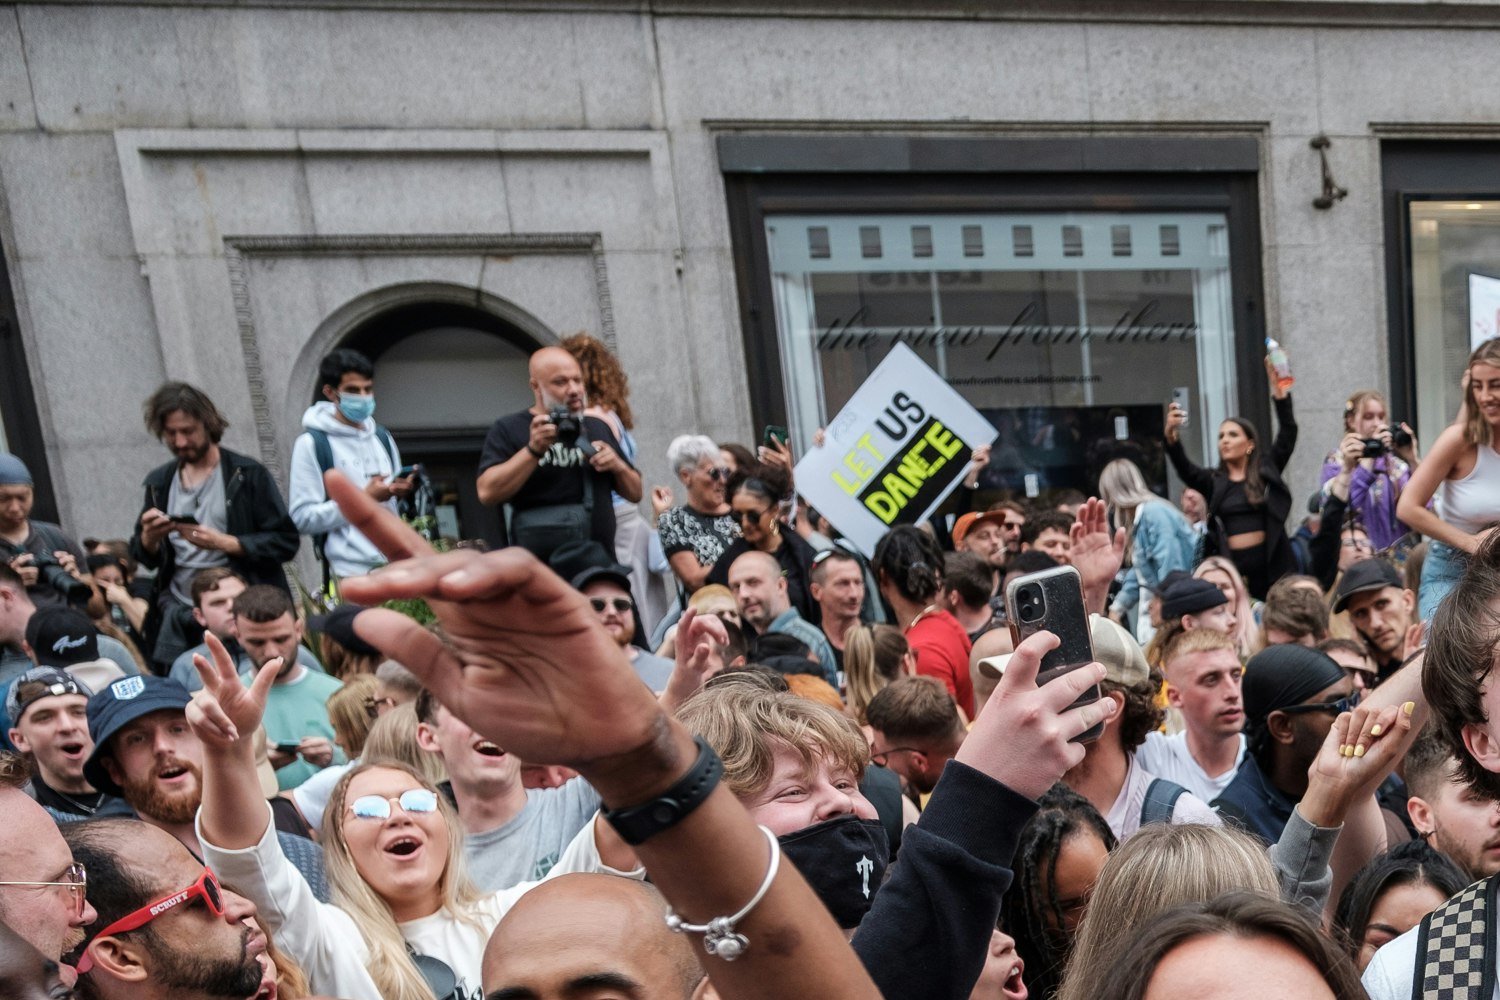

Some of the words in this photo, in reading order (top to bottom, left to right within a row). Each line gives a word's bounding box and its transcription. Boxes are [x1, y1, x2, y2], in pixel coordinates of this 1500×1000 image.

[816, 304, 881, 351] the
[985, 301, 1091, 362] from
[831, 432, 885, 496] LET
[875, 390, 925, 441] US
[149, 890, 188, 916] SCRUFF
